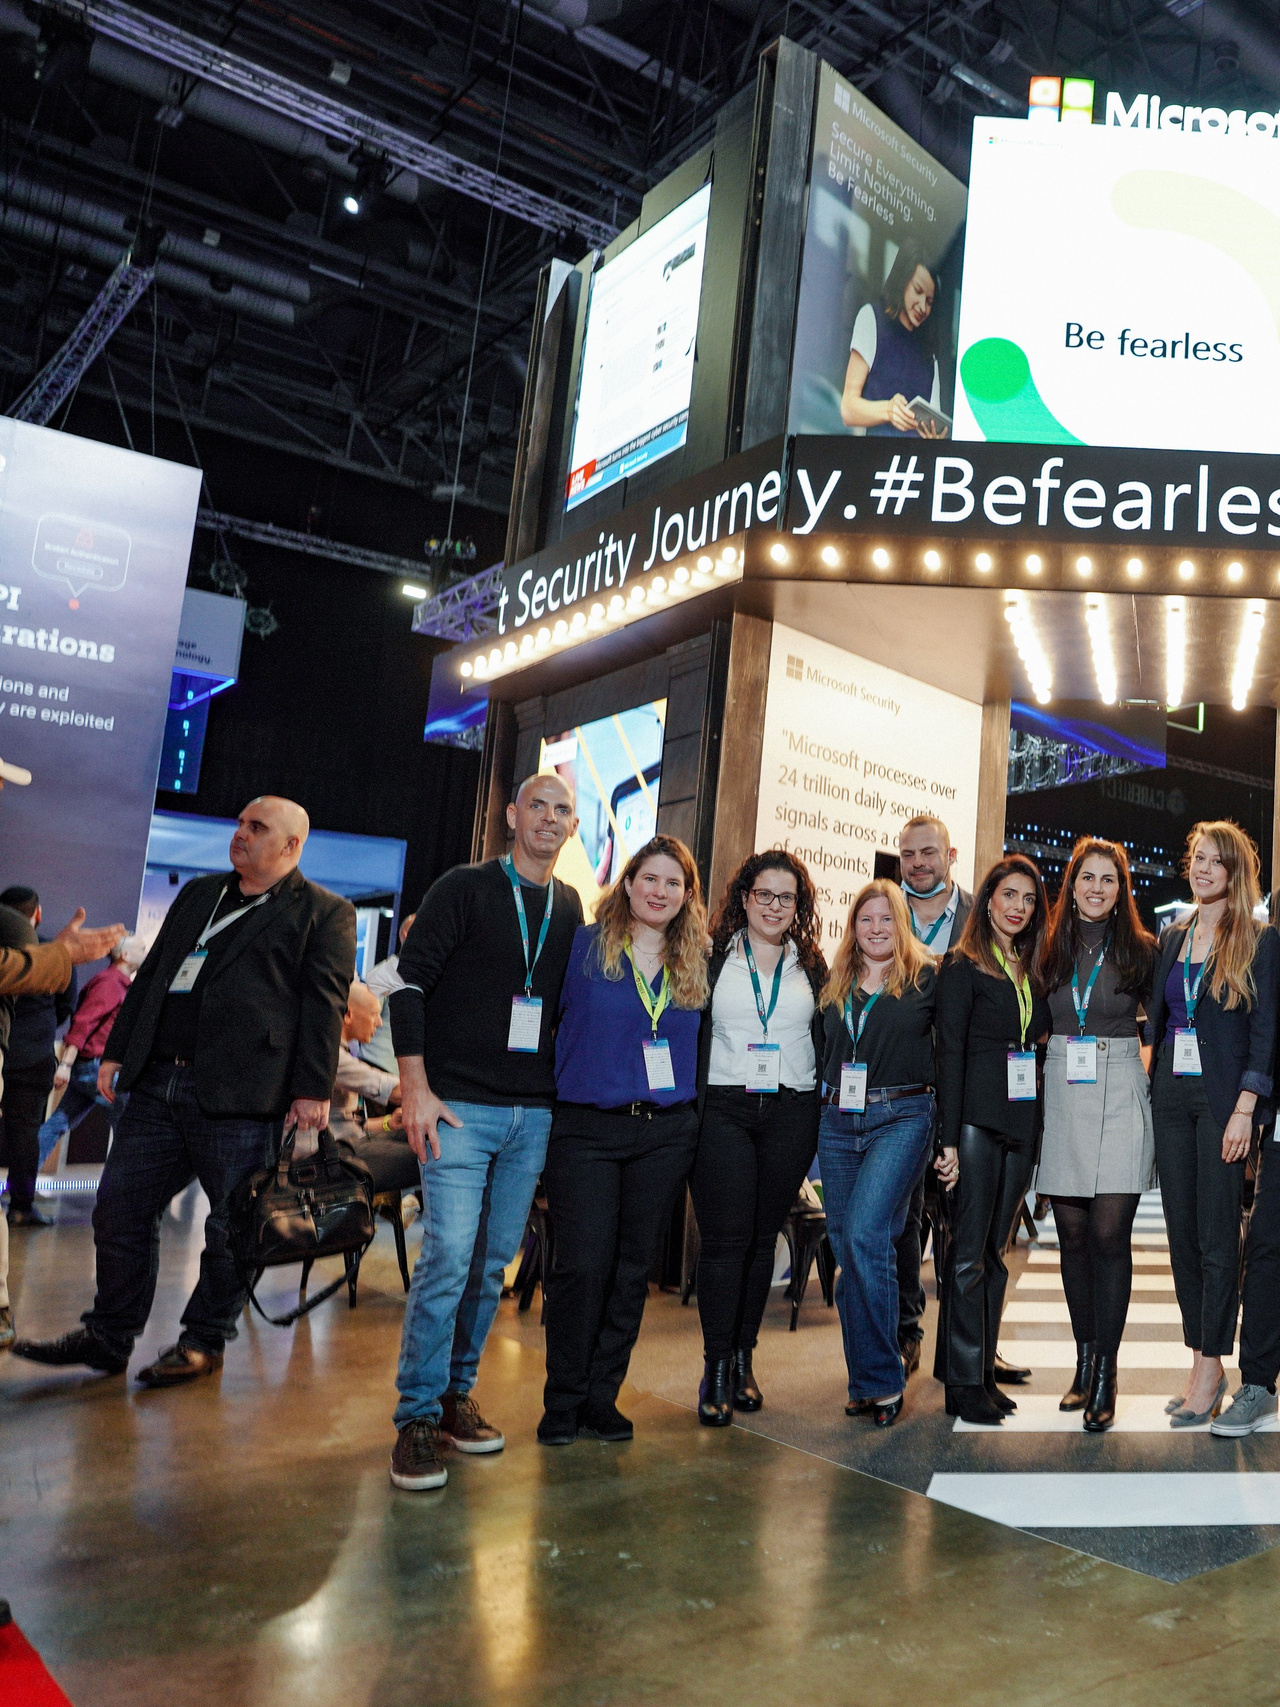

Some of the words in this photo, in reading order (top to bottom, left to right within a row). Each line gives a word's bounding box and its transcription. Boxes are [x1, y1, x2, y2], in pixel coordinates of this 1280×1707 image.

[852, 101, 899, 153] Microsoft
[900, 145, 938, 188] Security
[828, 160, 844, 186] Be
[847, 176, 895, 226] Fearless
[830, 141, 861, 179] Limit
[863, 169, 914, 223] Nothing.
[831, 121, 873, 167] Secure
[875, 159, 937, 222] Everything.
[1065, 322, 1105, 350] Be
[1117, 328, 1244, 363] fearless
[514, 531, 637, 629] Security
[642, 467, 858, 571] Journey.
[0, 624, 116, 664] rations
[9, 702, 37, 719] are
[40, 708, 115, 732] exploited
[38, 684, 70, 702] and
[806, 666, 858, 699] Microsoft
[860, 687, 902, 717] Security
[782, 729, 860, 772] "Microsoft
[863, 758, 928, 793] processes
[930, 780, 958, 801] over
[777, 765, 798, 789] 24
[803, 773, 851, 803] trillion
[854, 787, 887, 818] daily
[775, 801, 829, 832] signals
[832, 819, 877, 844] across
[880, 832, 889, 846] a
[794, 847, 872, 878] endpoints,
